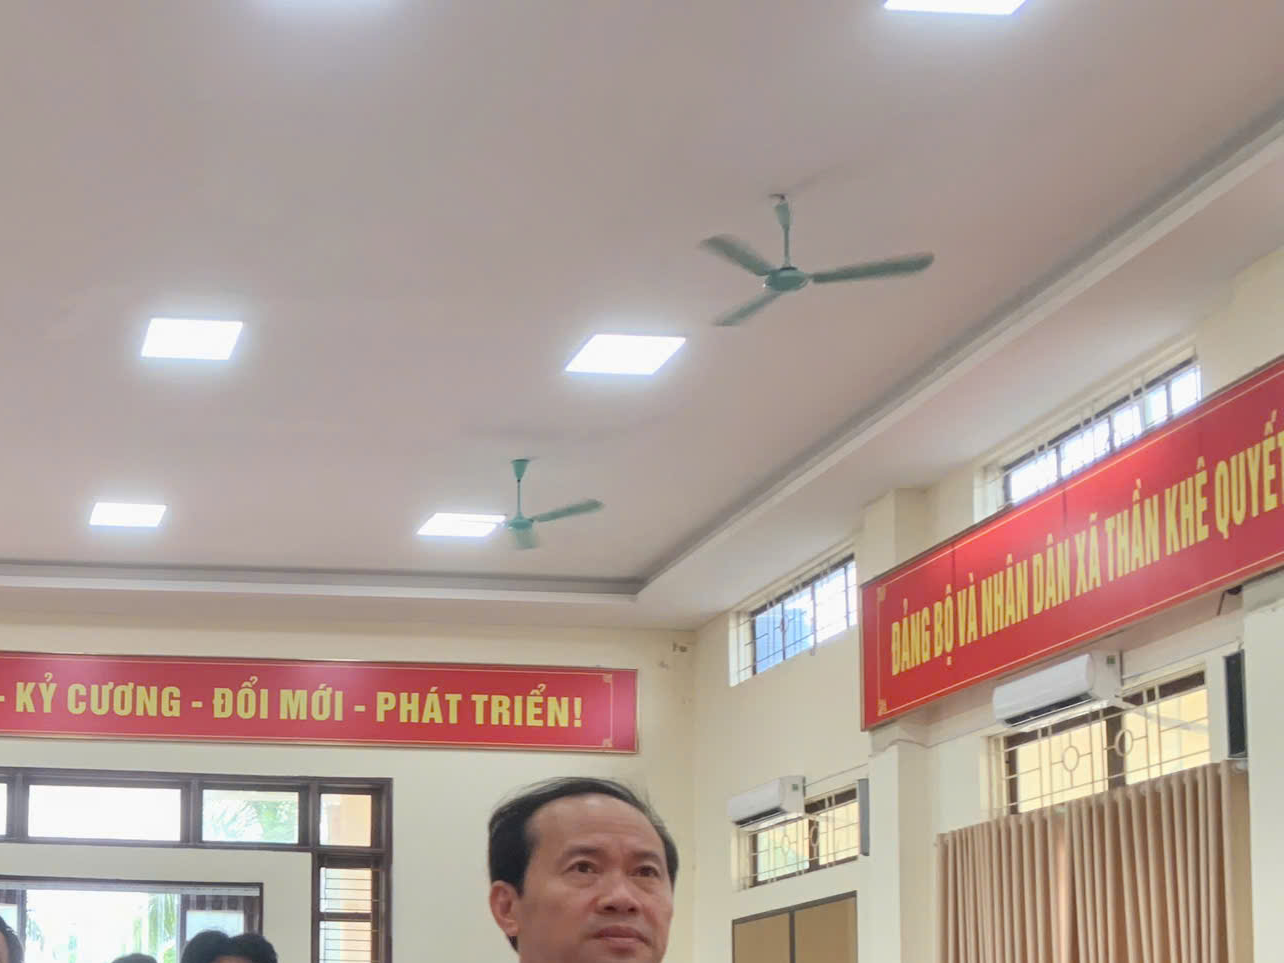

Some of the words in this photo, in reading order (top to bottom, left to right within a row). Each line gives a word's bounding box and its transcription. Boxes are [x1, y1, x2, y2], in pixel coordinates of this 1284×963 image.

[891, 598, 931, 676] ĐẢNG
[933, 583, 954, 666] BỘ
[957, 572, 978, 647] VÀ
[981, 553, 1029, 638] NHÂN
[1032, 533, 1071, 615] DÂN
[1075, 512, 1101, 597] XÃ
[1105, 478, 1160, 582] THẦN
[1165, 456, 1209, 556] KHÊ
[16, 671, 58, 713] KỶ
[67, 682, 180, 718] CƯƠNG
[212, 675, 268, 720] ĐỔI
[279, 684, 343, 721] MỚI
[376, 686, 462, 724] PHÁT
[470, 683, 582, 728] TRIỂN!
